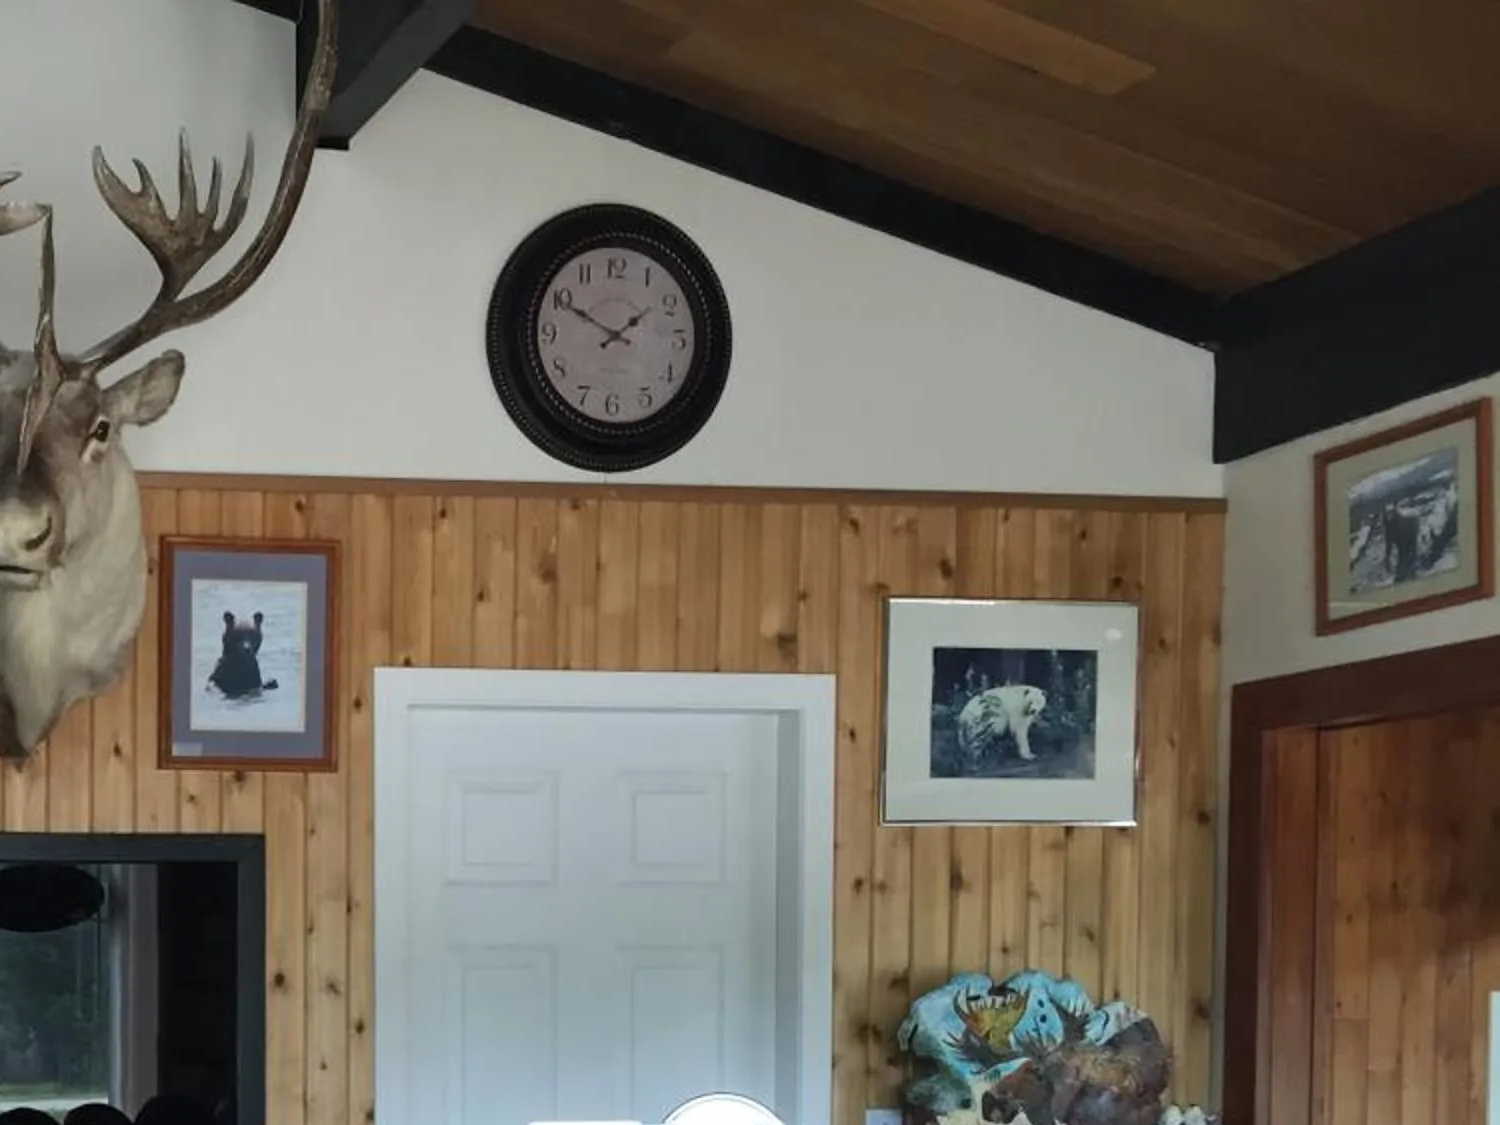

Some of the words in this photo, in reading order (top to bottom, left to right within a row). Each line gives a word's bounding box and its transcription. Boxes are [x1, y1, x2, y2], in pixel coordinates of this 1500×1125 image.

[579, 263, 592, 285] 11
[607, 257, 627, 279] 12
[643, 266, 652, 286] 1
[661, 294, 678, 317] 2
[541, 322, 557, 344] 9
[553, 357, 567, 378] 8
[577, 385, 591, 407] 7
[605, 395, 620, 416] 6
[637, 386, 653, 409] 5
